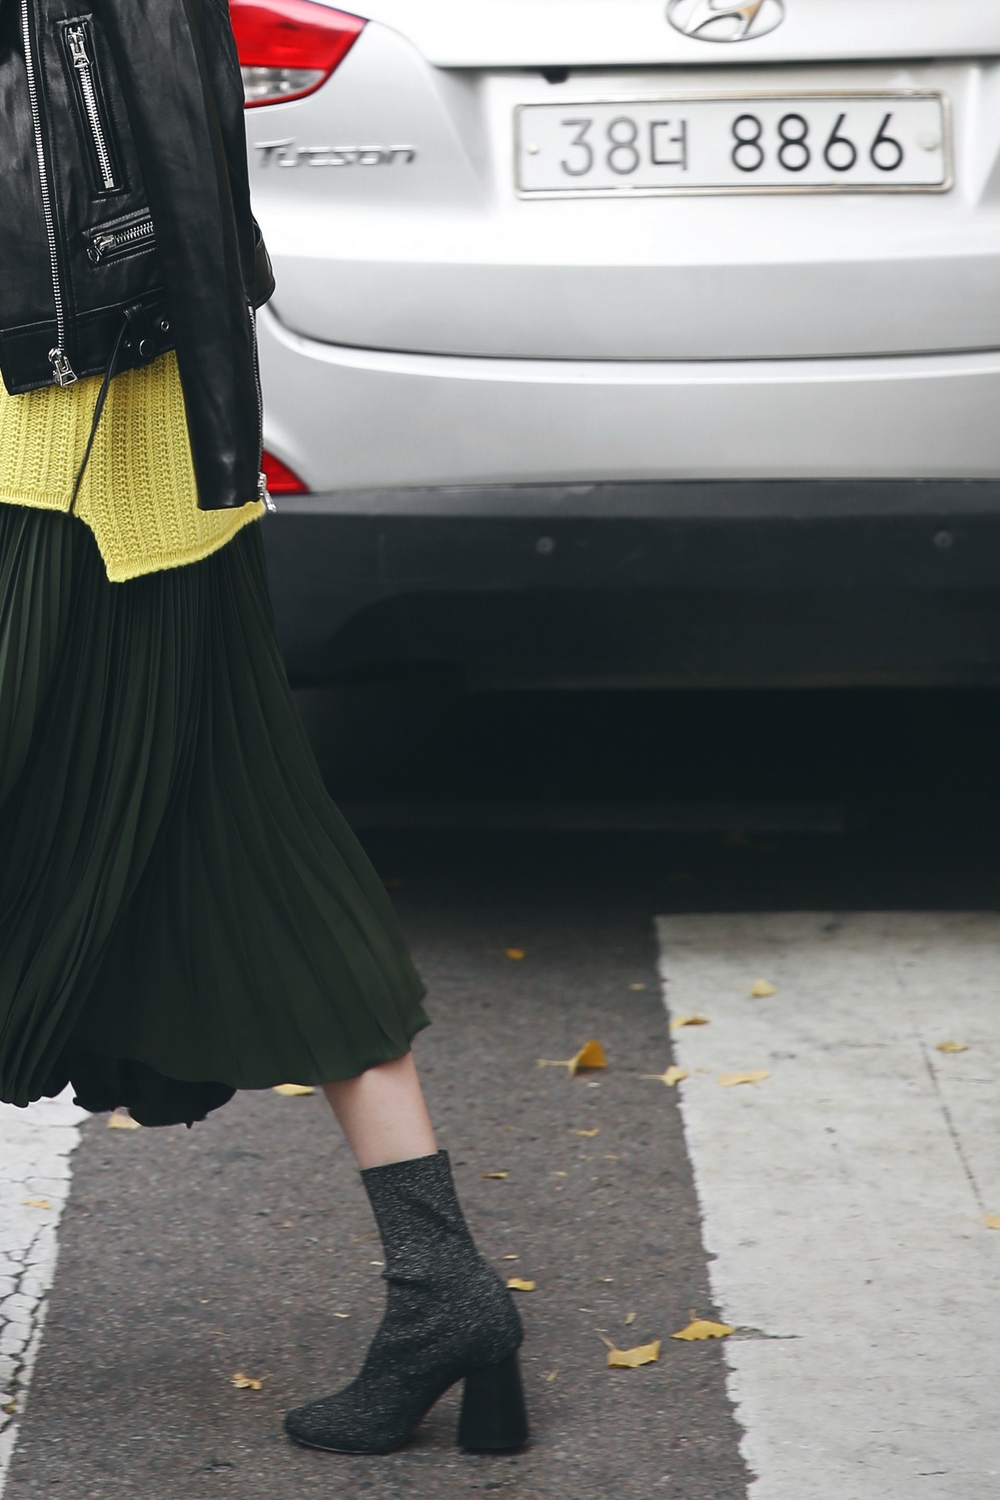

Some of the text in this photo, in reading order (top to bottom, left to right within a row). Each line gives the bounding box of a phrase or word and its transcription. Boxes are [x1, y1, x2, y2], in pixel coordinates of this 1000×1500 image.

[253, 137, 416, 168] Tucson
[559, 112, 904, 176] 38더 8866
